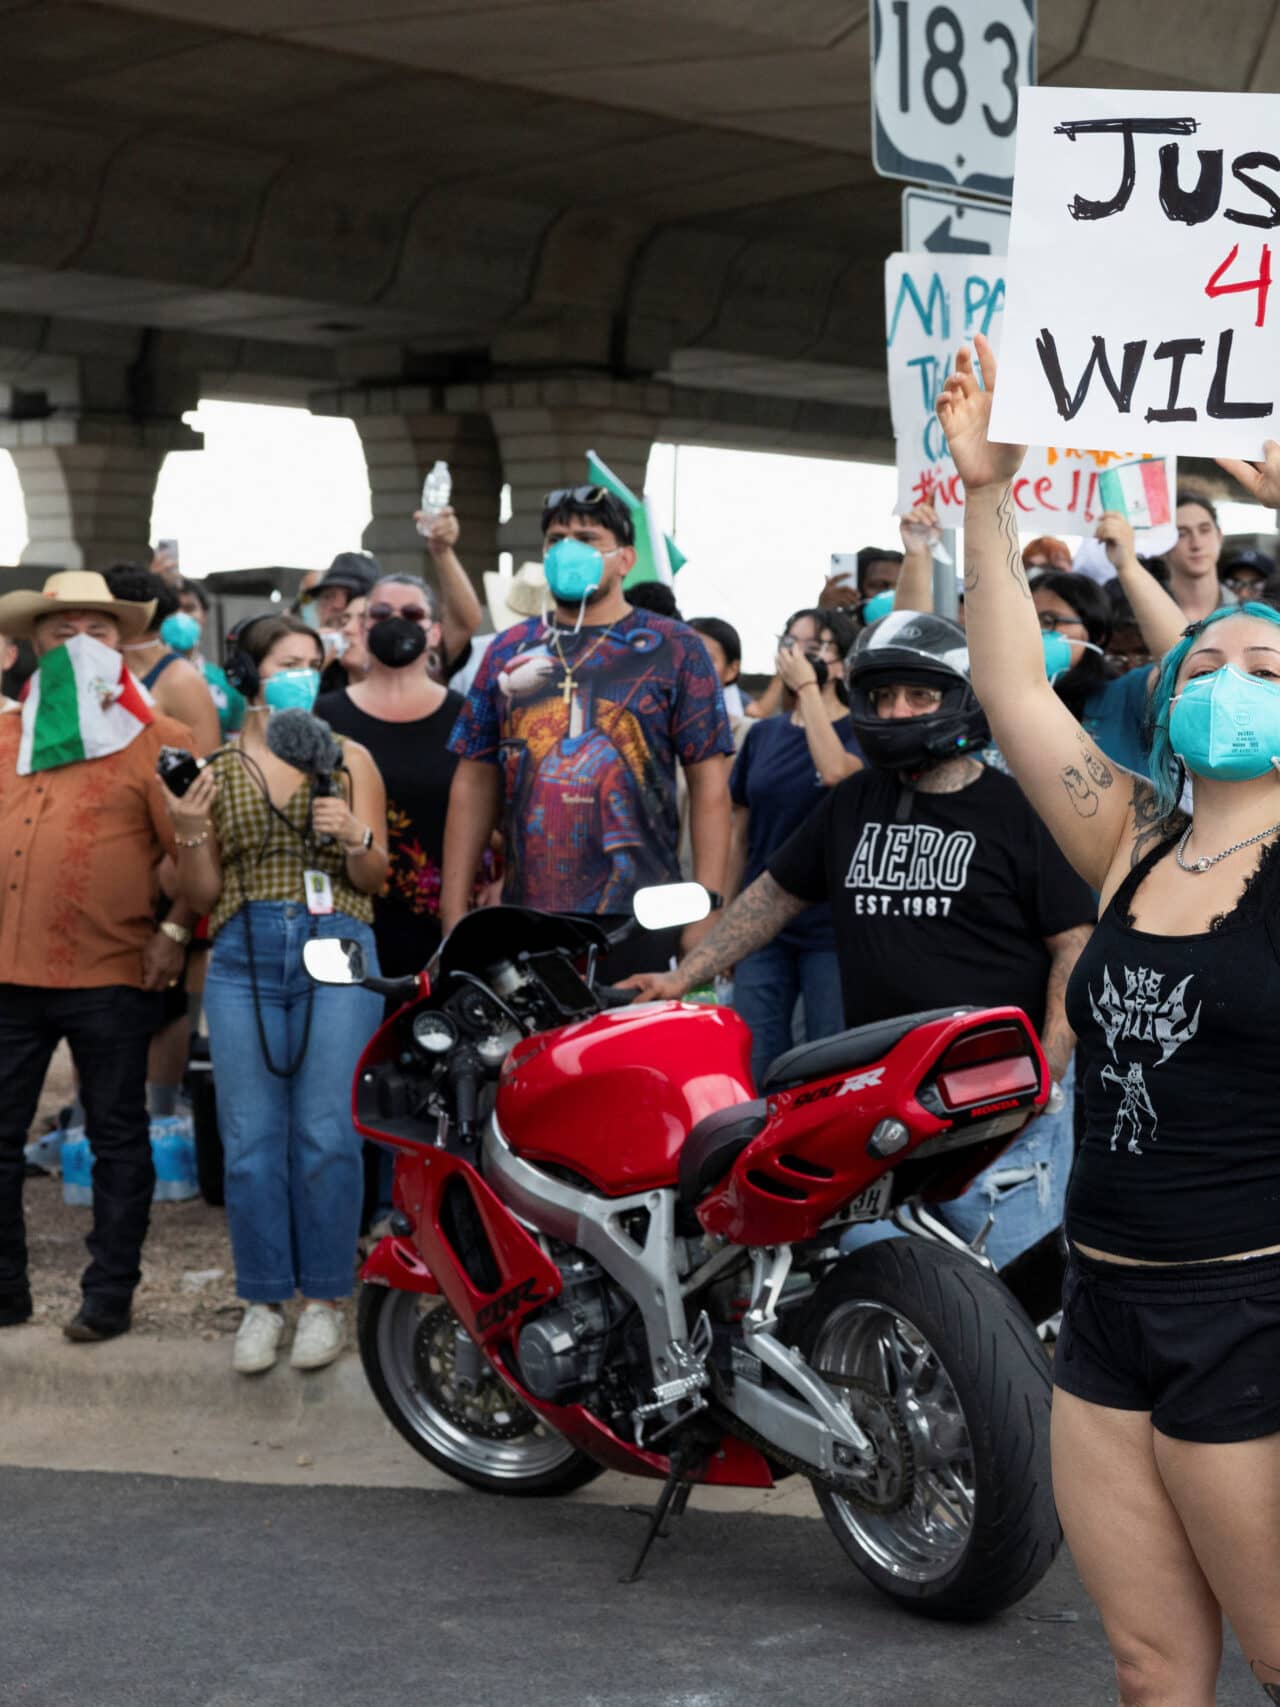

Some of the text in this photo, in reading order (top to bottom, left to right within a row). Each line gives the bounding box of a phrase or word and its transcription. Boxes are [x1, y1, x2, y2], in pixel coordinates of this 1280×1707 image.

[893, 0, 1018, 137] 183
[1204, 243, 1272, 327] 4
[844, 822, 977, 891] AERO
[855, 894, 952, 917] EST.1987
[970, 1098, 1020, 1119] HONDA
